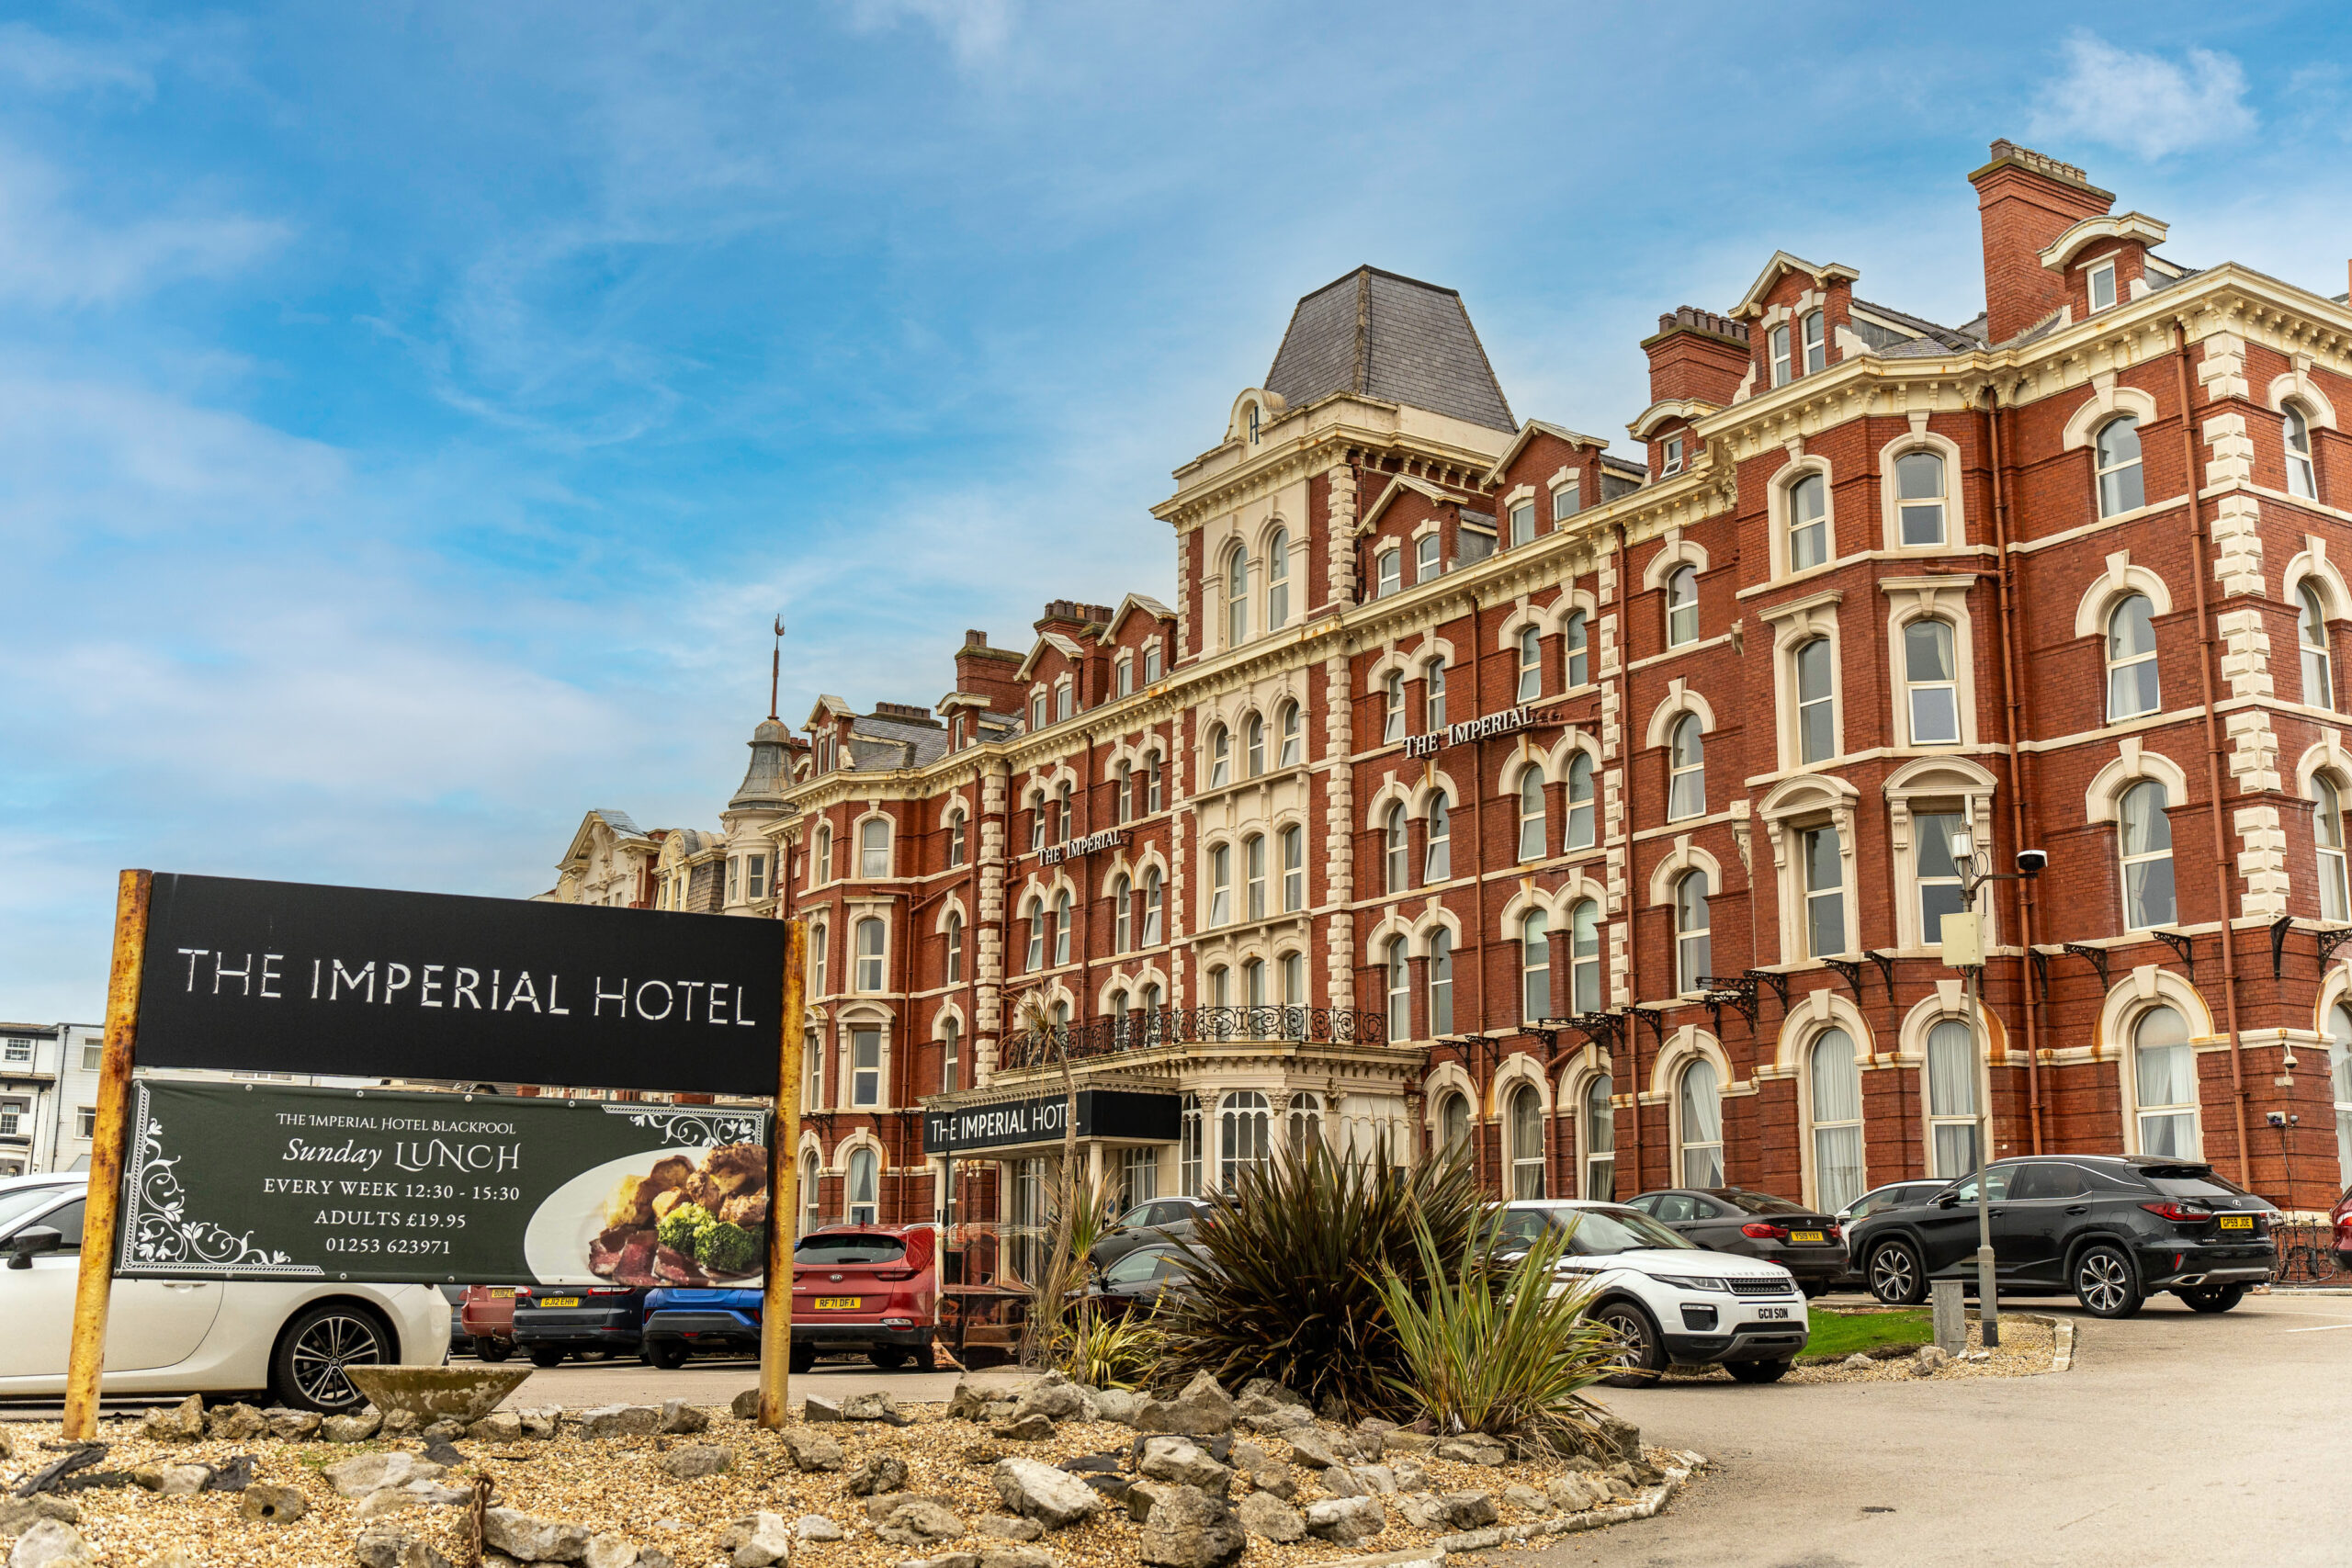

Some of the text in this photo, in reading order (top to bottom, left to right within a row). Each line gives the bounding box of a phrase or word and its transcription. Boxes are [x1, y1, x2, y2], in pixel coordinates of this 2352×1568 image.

[1403, 706, 1533, 759] THE IMPERIAL
[1037, 829, 1121, 866] THE IMPERIAL
[177, 948, 755, 1025] THE IMPERIAL HOTEL
[276, 1113, 516, 1134] THE IMPERIAL HOTEL BLACKPOOL
[932, 1103, 1080, 1143] THE IMPERIAL HOTE
[282, 1138, 522, 1173] Sunday LUNCH
[264, 1178, 334, 1194] EVERY
[340, 1180, 399, 1197] WEEK
[405, 1184, 453, 1199] 12:30
[472, 1186, 520, 1201] 15:30
[314, 1210, 466, 1228] ADULTS £19.95
[326, 1237, 450, 1255] 01253 623971
